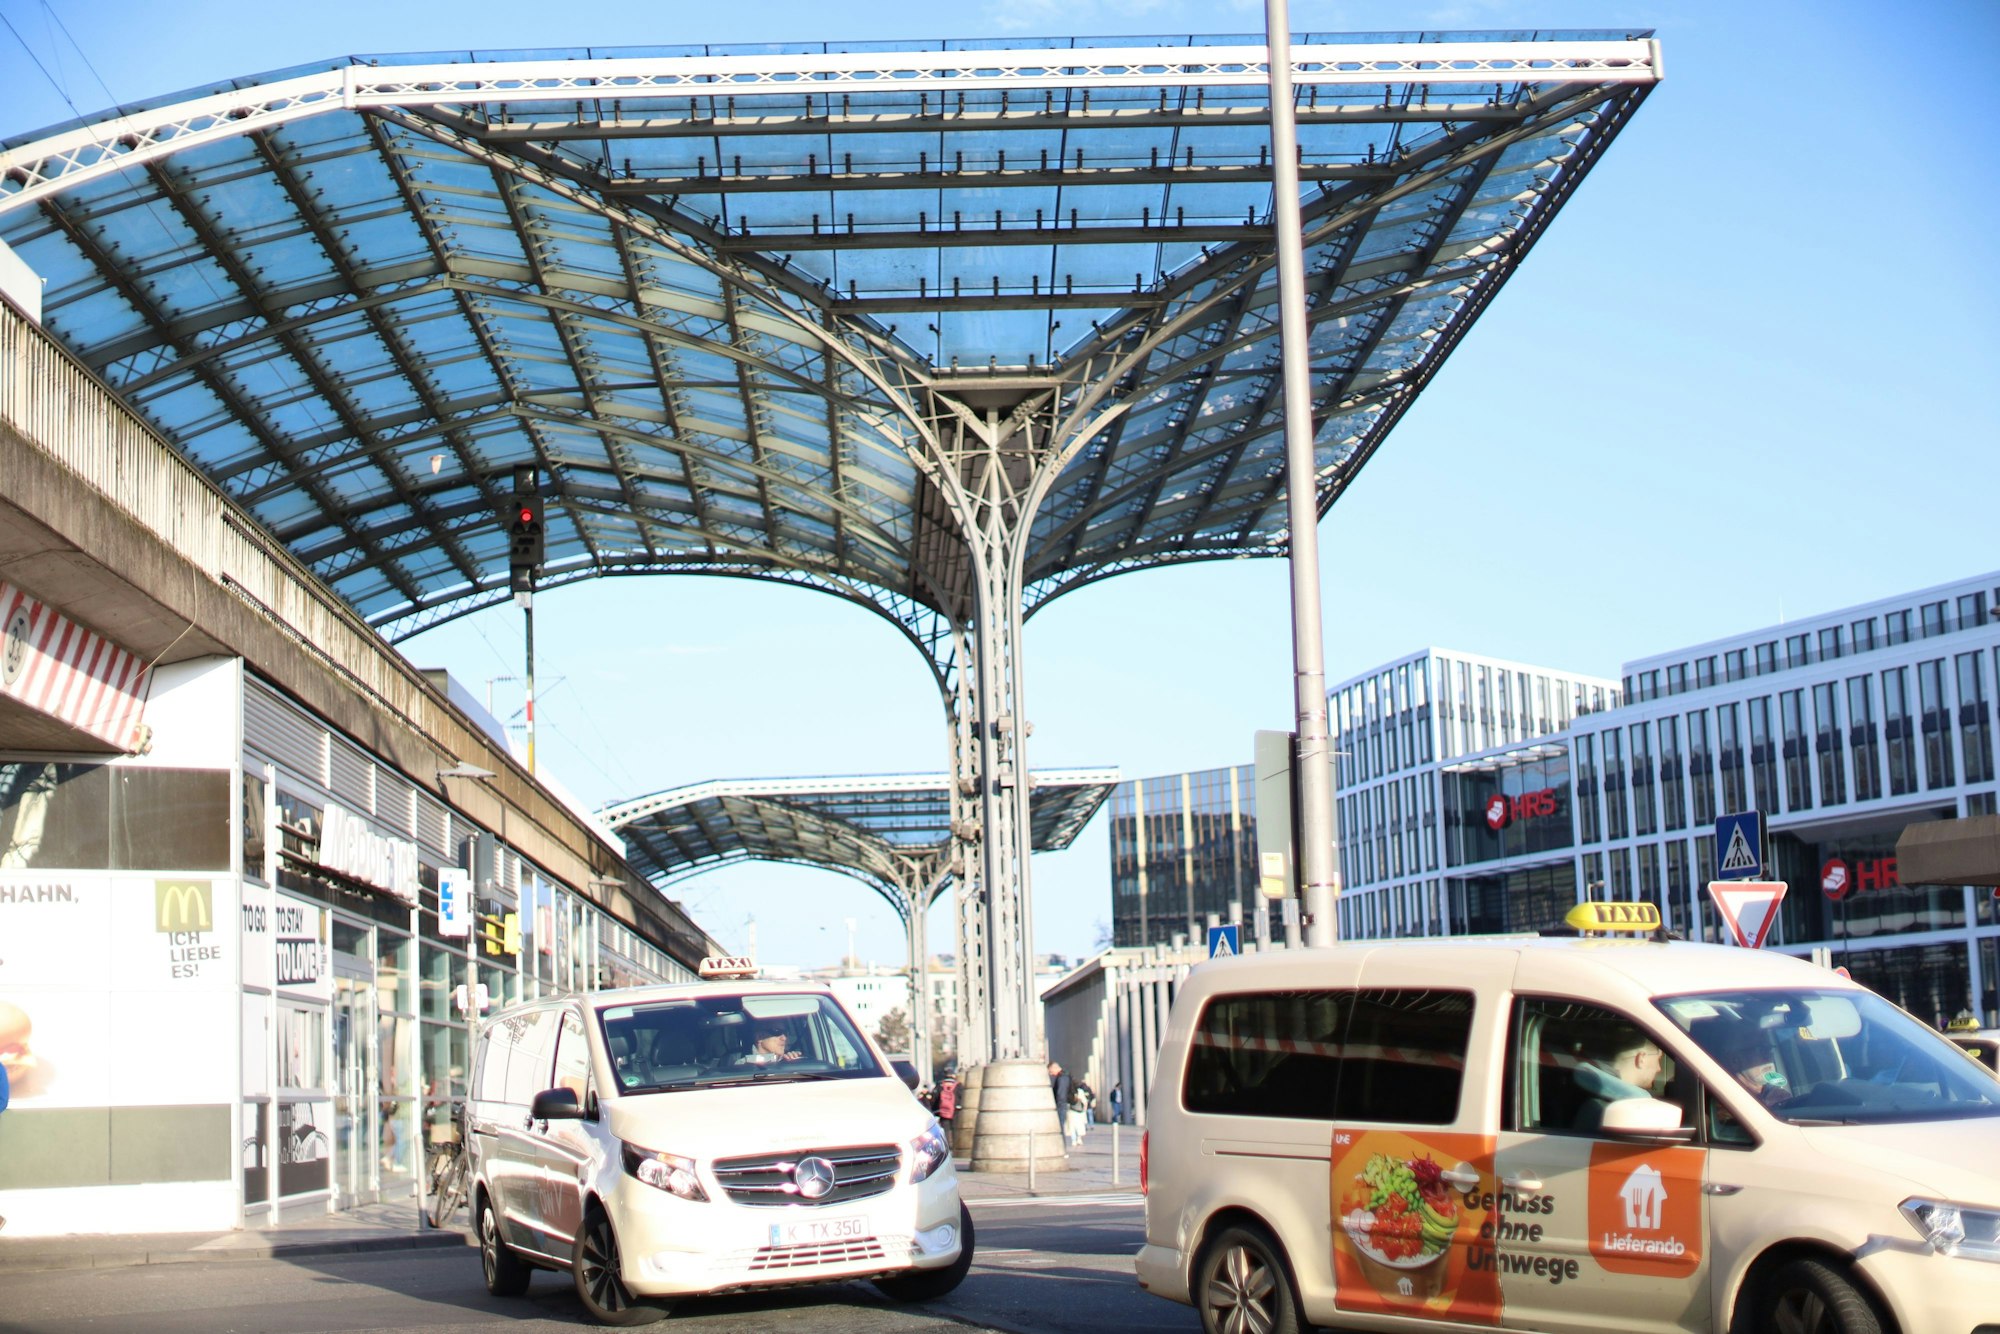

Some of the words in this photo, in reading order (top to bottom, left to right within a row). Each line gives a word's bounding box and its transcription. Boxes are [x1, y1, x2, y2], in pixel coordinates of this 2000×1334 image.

[1510, 787, 1557, 822] HRS
[1857, 857, 1903, 892] HR
[242, 904, 254, 932] TO
[276, 906, 286, 933] TO
[1600, 905, 1651, 923] TAXI
[168, 930, 201, 946] ICH
[169, 945, 222, 963] LIEBE
[276, 941, 291, 981] TO
[706, 957, 751, 969] TAXI
[171, 963, 200, 979] ES!
[1462, 1186, 1555, 1215] Genuss
[788, 1225, 798, 1241] K
[809, 1223, 830, 1239] TX
[833, 1219, 862, 1237] 350
[1480, 1214, 1544, 1242] ohne
[1604, 1232, 1685, 1256] Lieferando
[1467, 1244, 1580, 1285] Umwege
